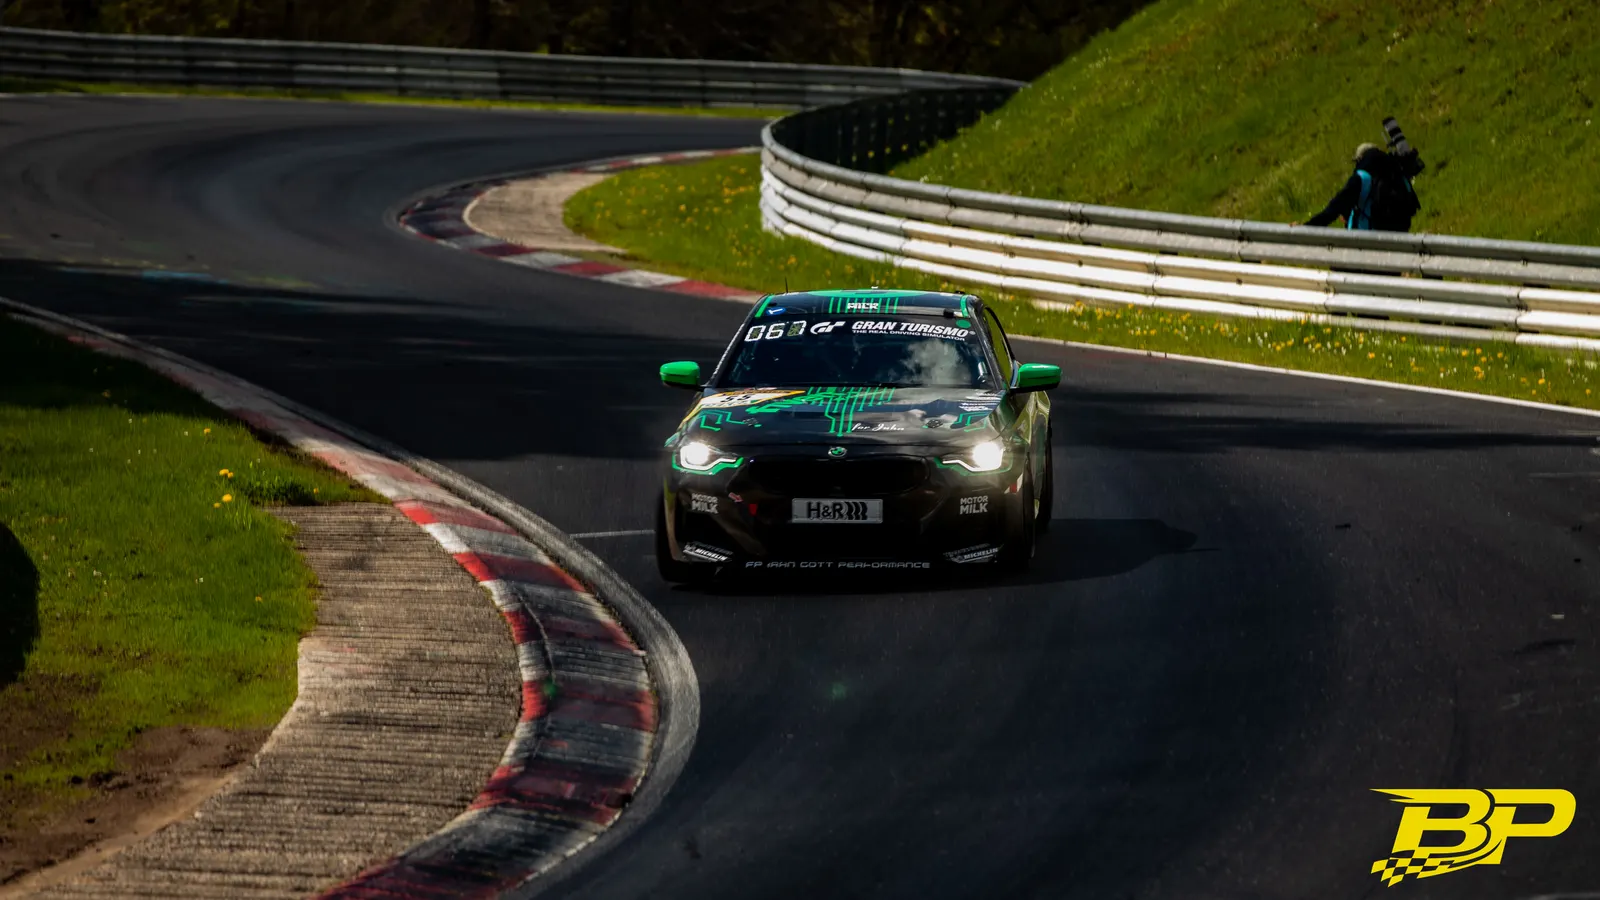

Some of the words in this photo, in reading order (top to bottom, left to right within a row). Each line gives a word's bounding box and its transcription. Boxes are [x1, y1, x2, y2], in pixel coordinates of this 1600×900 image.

[852, 321, 897, 330] GRAN
[899, 322, 969, 337] TURISMO
[922, 332, 966, 341] SIMULATOR
[720, 394, 751, 402] 55
[851, 422, 870, 431] for
[691, 493, 718, 503] MOTOR
[960, 495, 989, 504] MOTOR
[691, 500, 719, 514] MILK
[959, 503, 989, 515] MILK
[695, 548, 728, 561] MICHELIN
[963, 547, 999, 559] MICHELIN
[837, 561, 931, 569] PERFORMANCE
